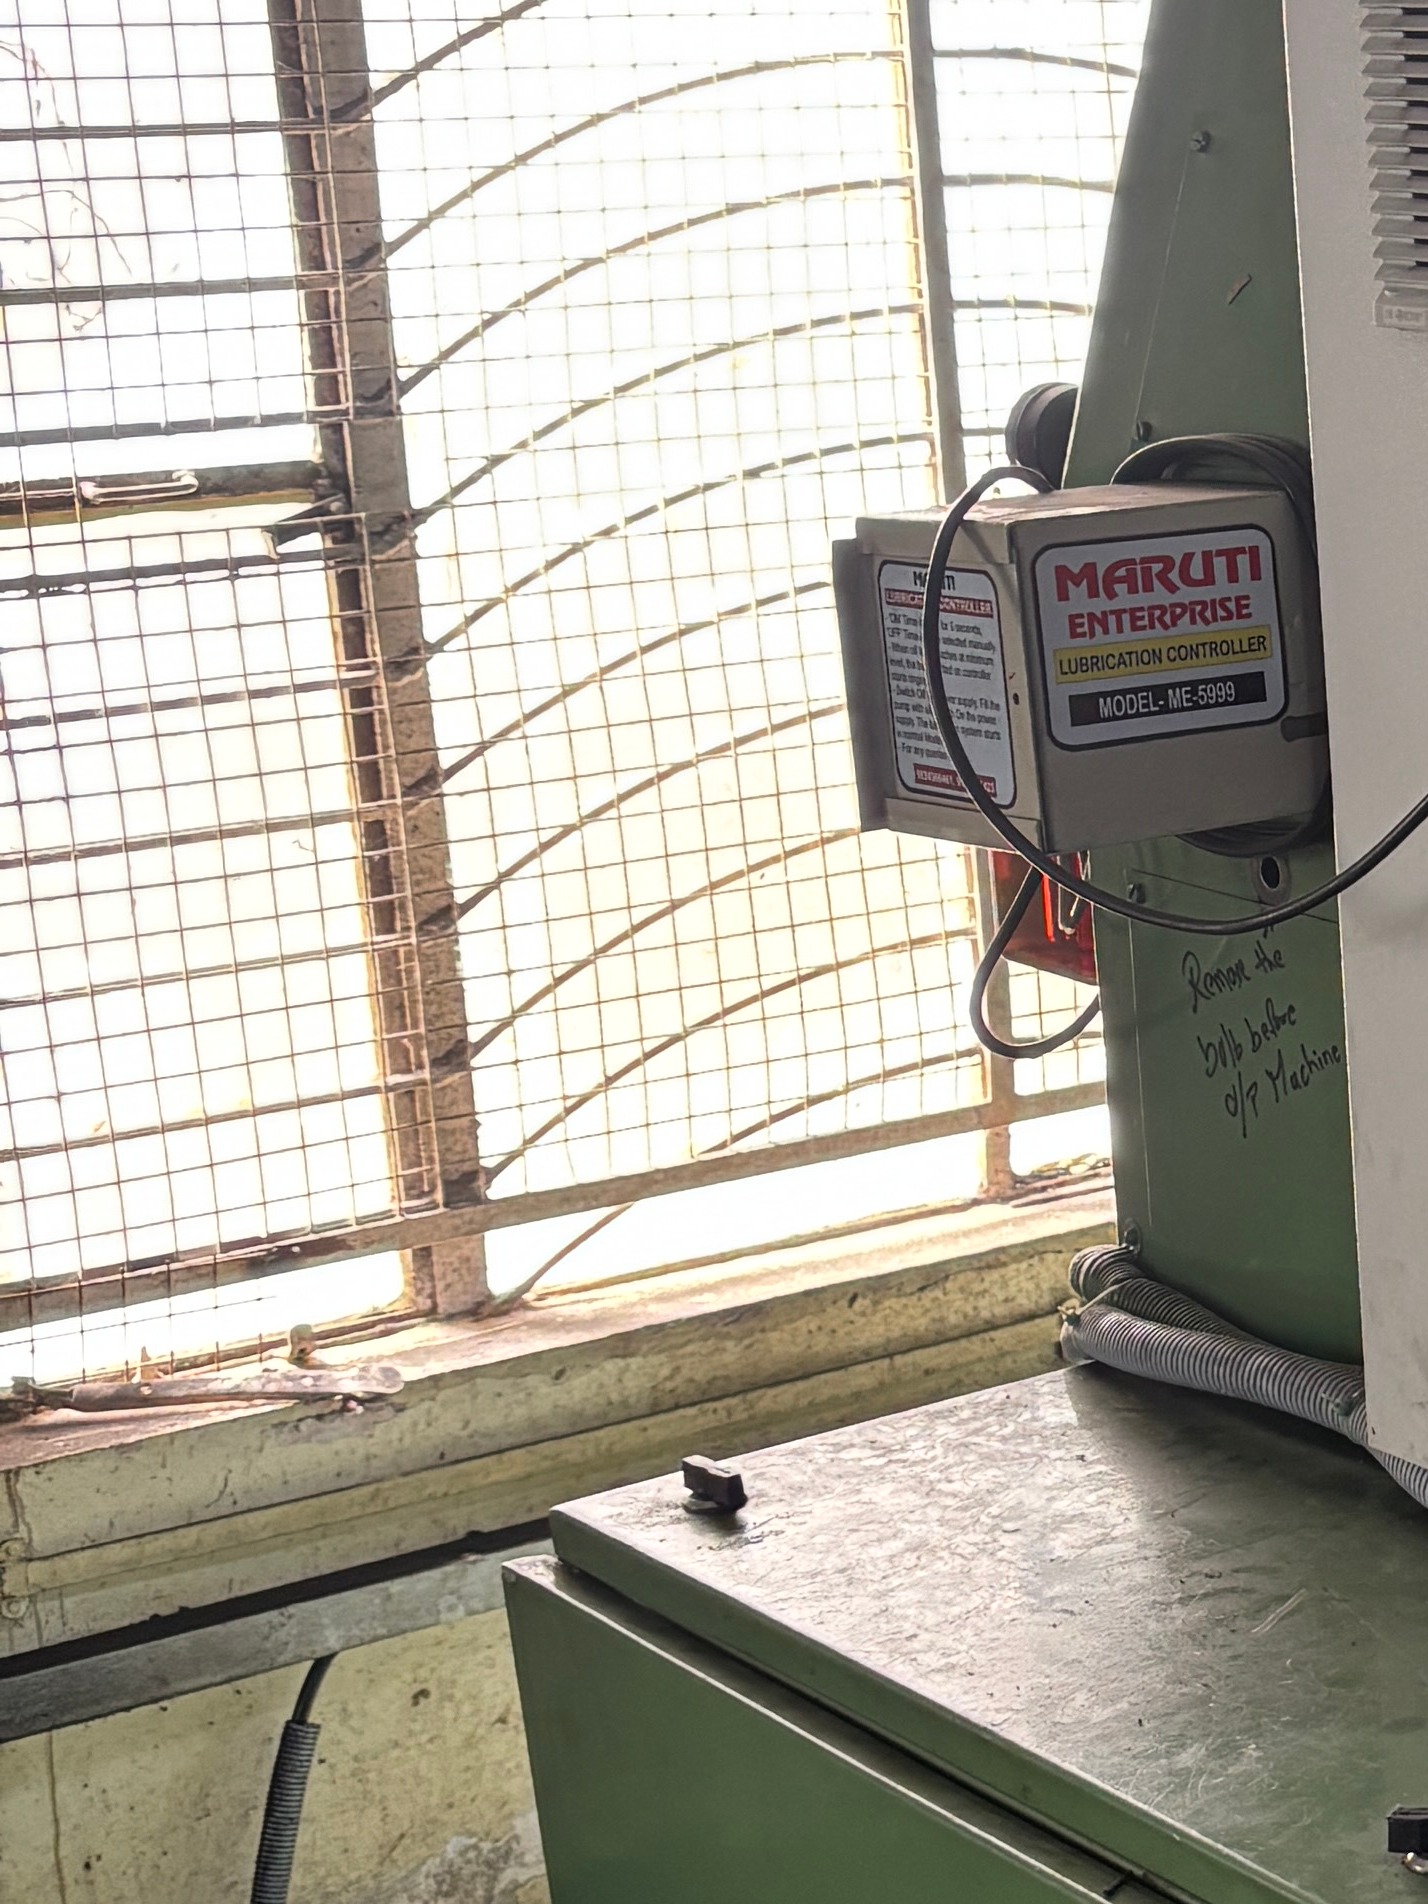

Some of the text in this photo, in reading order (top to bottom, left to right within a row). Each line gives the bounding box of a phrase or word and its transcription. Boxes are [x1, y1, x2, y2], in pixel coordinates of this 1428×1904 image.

[1055, 545, 1262, 602] MARUTI
[1068, 595, 1252, 640] ENTERPRISE
[1059, 635, 1267, 676] LUBRICATION CONTROLLER
[1099, 681, 1235, 719] MODEL- ME-5999
[1245, 997, 1296, 1054] before
[1266, 1044, 1341, 1104] Machine
